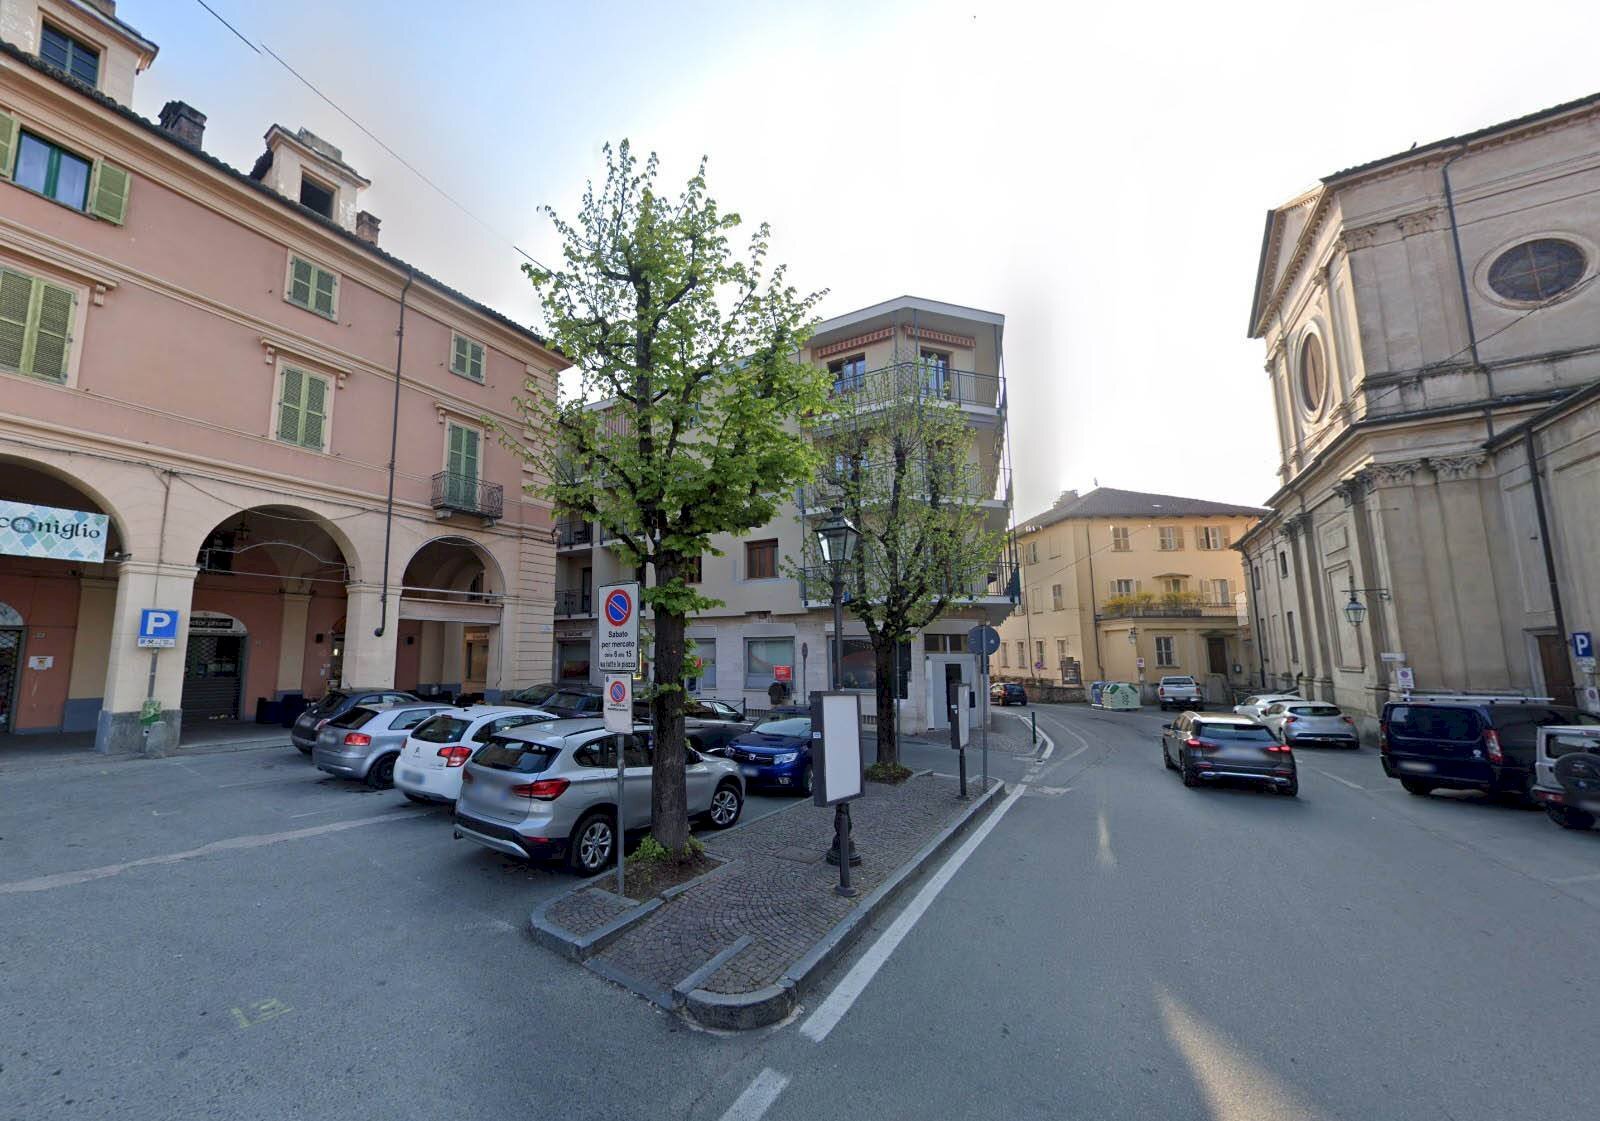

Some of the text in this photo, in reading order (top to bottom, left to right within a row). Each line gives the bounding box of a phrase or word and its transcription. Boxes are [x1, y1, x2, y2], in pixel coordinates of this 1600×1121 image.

[146, 612, 172, 635] P
[608, 630, 629, 638] Sabato
[601, 641, 611, 649] per
[1575, 634, 1589, 656] P
